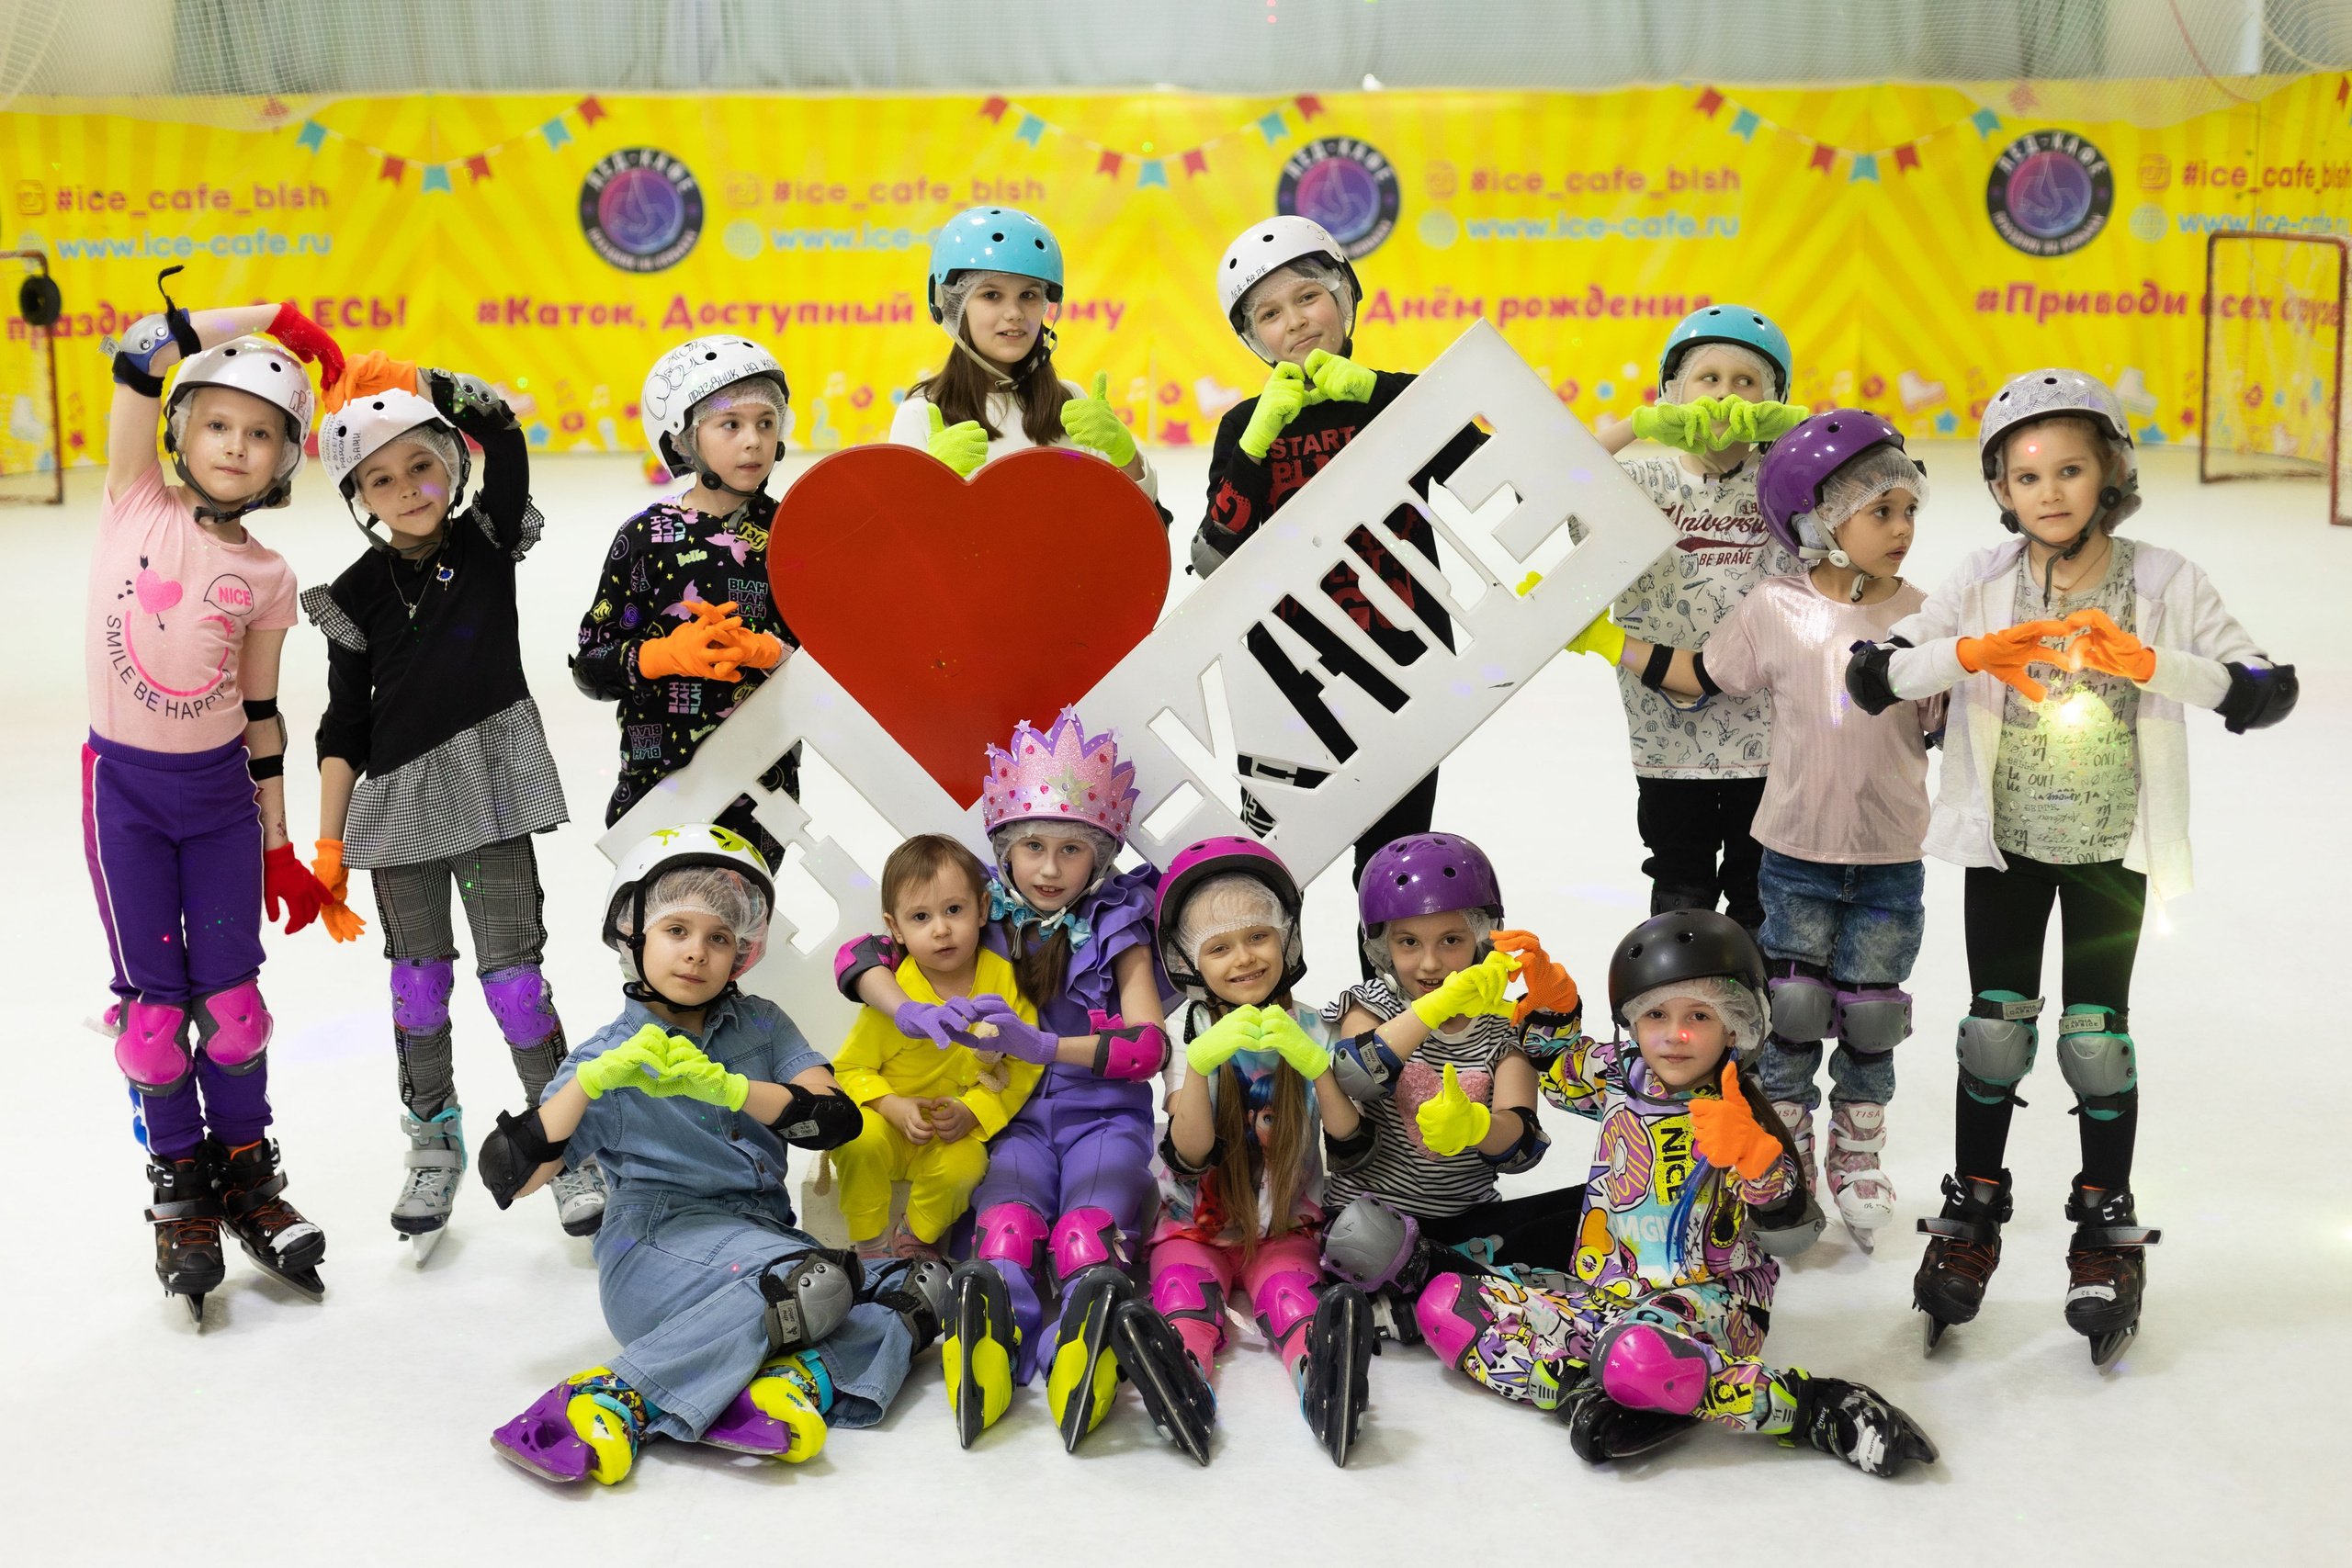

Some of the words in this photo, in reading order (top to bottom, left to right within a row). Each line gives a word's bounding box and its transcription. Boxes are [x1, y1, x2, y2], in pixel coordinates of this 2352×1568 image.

[56, 228, 333, 260] www.ice-cafe.ru
[478, 295, 646, 331] #Каток,
[662, 291, 914, 335] Доступный
[1363, 286, 1482, 325] Днём
[1269, 425, 1356, 458] START
[650, 515, 662, 543] BLAH
[676, 549, 707, 567] hello
[1700, 553, 1713, 566] BE
[1716, 552, 1753, 565] BRAVE
[218, 586, 252, 606] NICE
[729, 578, 769, 594] BLAH
[729, 591, 766, 606] BLAH
[107, 615, 137, 684] SMILE
[133, 681, 161, 712] BE
[165, 690, 225, 719] HAPPY
[668, 682, 679, 713] BLAH
[679, 682, 690, 714] BLAH
[690, 682, 702, 714] BLAH
[628, 724, 662, 737] BLAH
[632, 747, 662, 760] BLAH
[2028, 774, 2054, 790] OUI!
[1855, 1110, 1881, 1119] TISA
[1660, 1126, 1686, 1202] NICE
